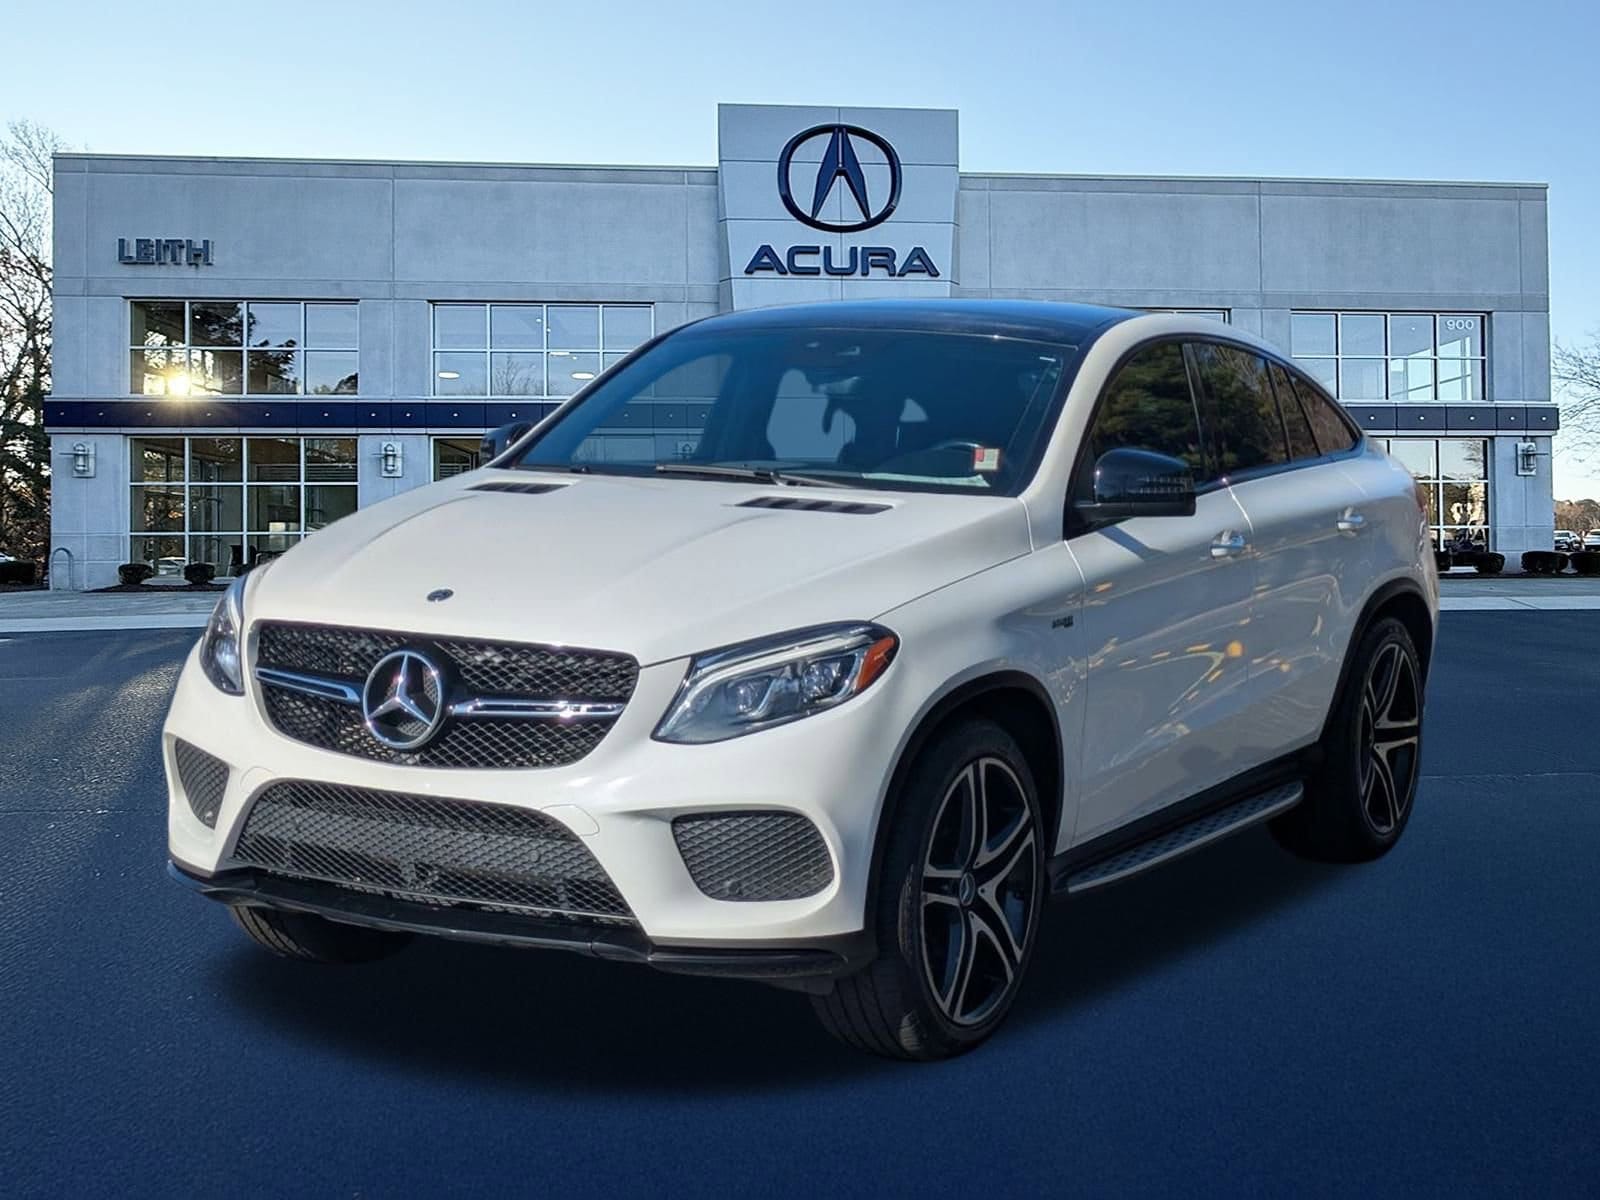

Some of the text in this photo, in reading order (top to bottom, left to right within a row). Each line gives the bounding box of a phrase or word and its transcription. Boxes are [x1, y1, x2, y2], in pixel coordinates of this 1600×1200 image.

[118, 238, 211, 264] LEITH
[744, 244, 940, 277] ACURA
[1447, 319, 1475, 330] 900
